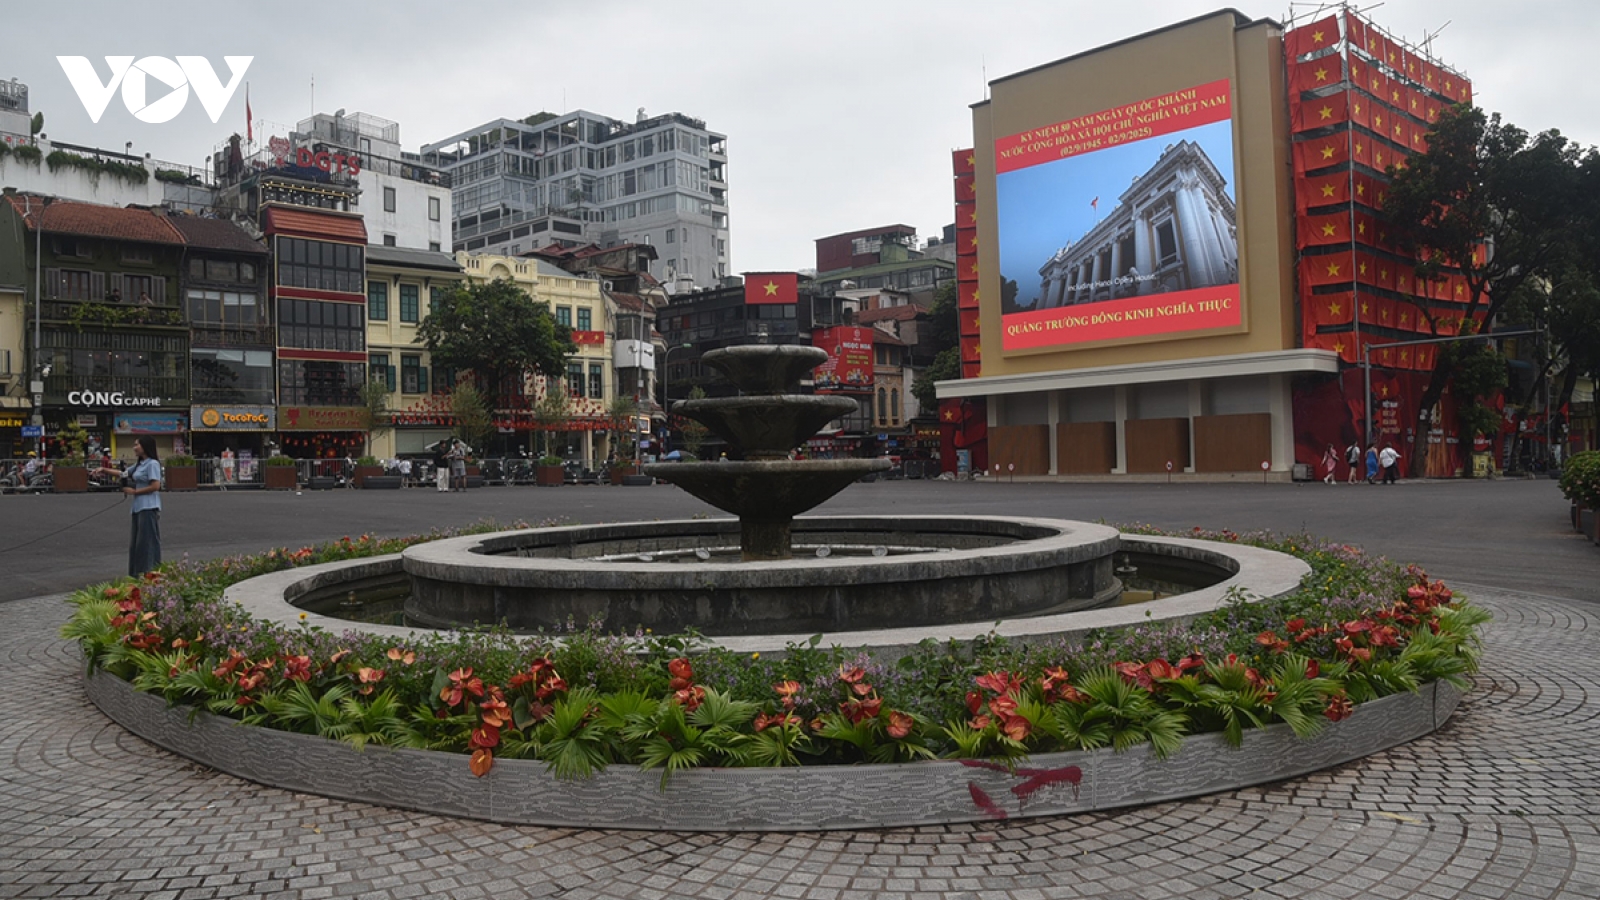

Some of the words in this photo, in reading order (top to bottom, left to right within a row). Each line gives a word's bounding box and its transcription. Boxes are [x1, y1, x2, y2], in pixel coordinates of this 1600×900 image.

[1028, 139, 1053, 153] CỘNG
[1093, 122, 1112, 136] HỘI
[1173, 101, 1199, 116] VIỆT
[1201, 95, 1227, 110] NAM
[1036, 124, 1060, 138] NIỆM
[1060, 122, 1071, 132] 80
[1072, 115, 1094, 129] NĂM
[1096, 107, 1123, 122] NGÀY
[1126, 99, 1155, 116] QUỐC
[1158, 88, 1197, 107] KHÁNH
[297, 147, 361, 176] DGTS
[1007, 321, 1043, 336] QUẢNG
[1045, 315, 1089, 330] TRƯỜNG
[1091, 310, 1122, 325] ĐÔNG
[1125, 307, 1154, 321] KINH
[1157, 301, 1195, 317] NGHĨA
[1198, 298, 1232, 314] THỤC
[67, 389, 123, 408] CỘNG
